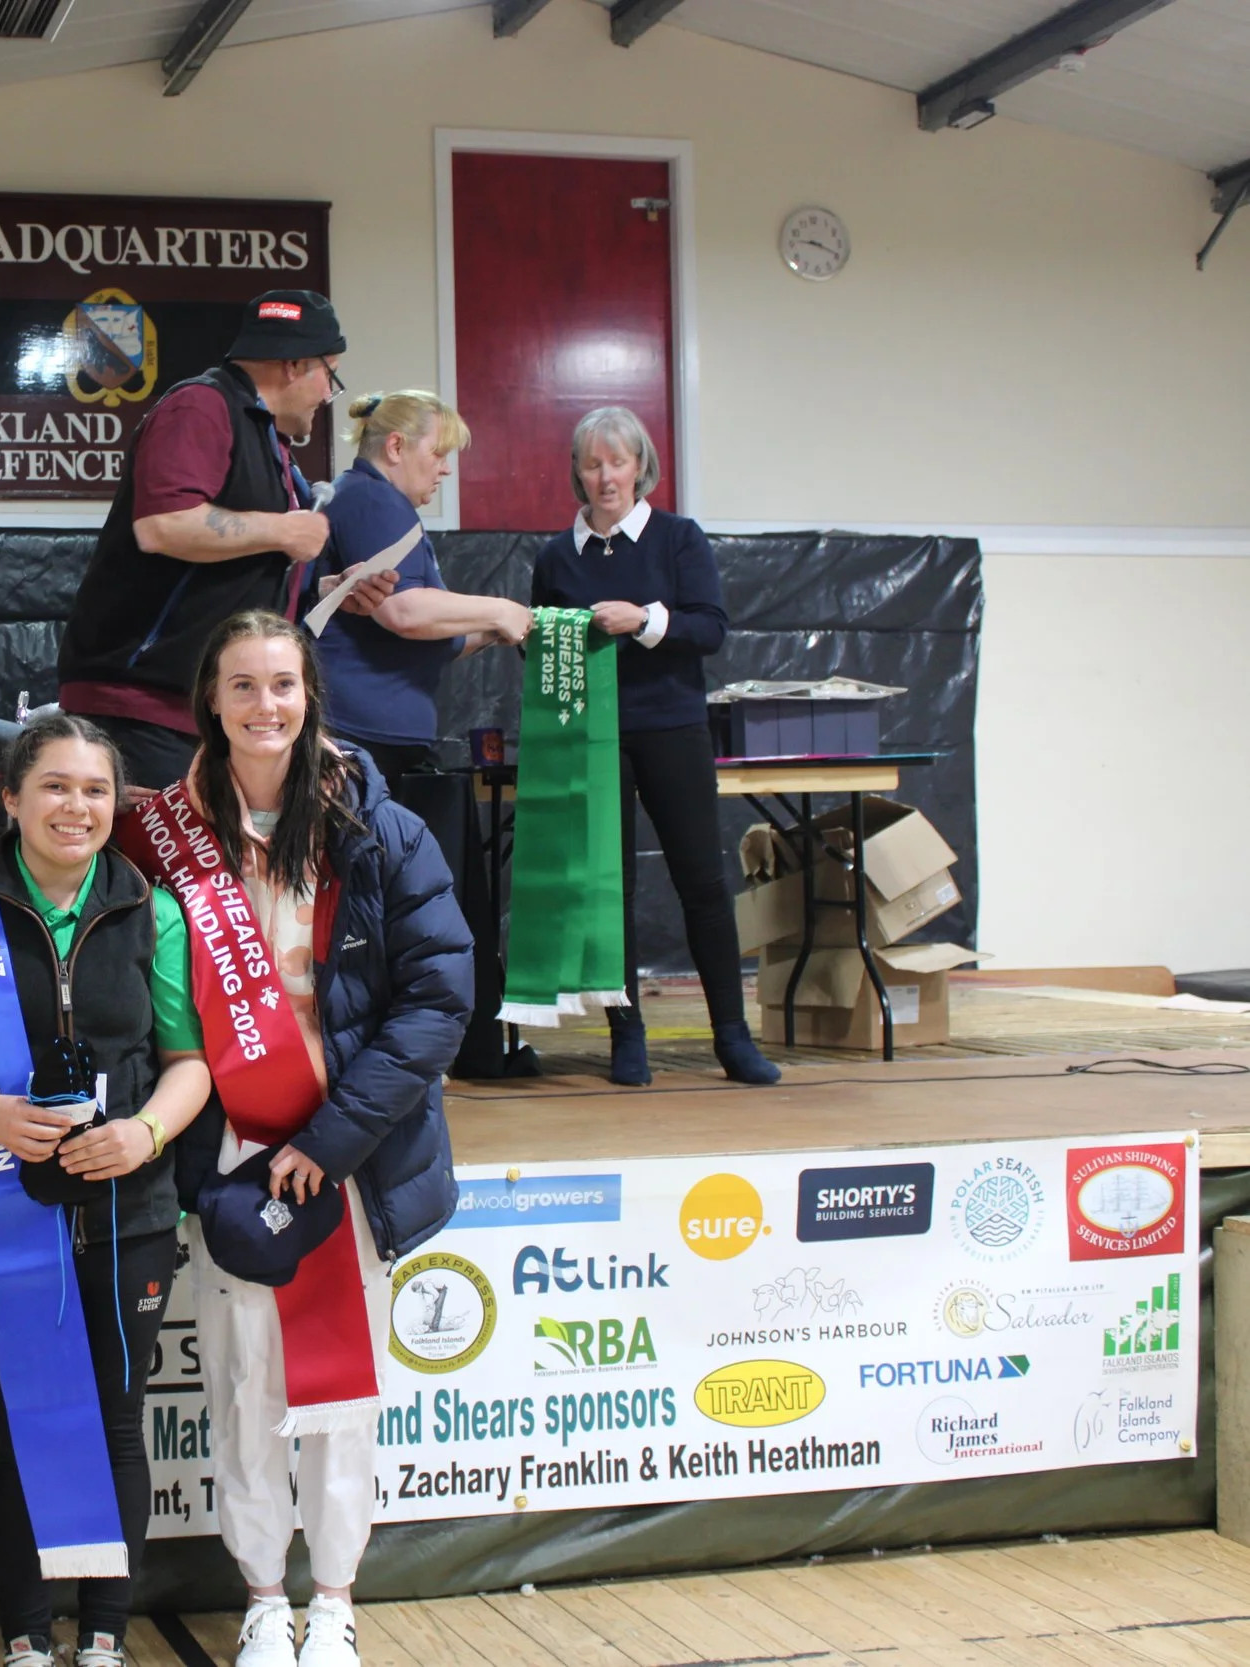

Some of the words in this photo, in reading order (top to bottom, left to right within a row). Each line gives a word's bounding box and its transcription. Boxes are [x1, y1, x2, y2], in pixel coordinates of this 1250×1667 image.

[258, 303, 301, 319] Heiniger
[541, 652, 555, 695] 2025
[558, 624, 572, 703] SHEARS
[141, 805, 180, 872] WOOL
[170, 865, 243, 997] HANDLING
[229, 999, 267, 1061] 2025
[210, 871, 270, 979] SHEARS
[951, 1161, 992, 1208] POLAR
[996, 1157, 1044, 1203] SEAFISH
[1072, 1151, 1122, 1183] SULIVAN
[1125, 1151, 1178, 1177] SHIPPING
[456, 1190, 604, 1212] dwoolgrowers
[816, 1183, 916, 1209] SHORTY'S
[816, 1209, 864, 1222] BUILDING
[869, 1206, 915, 1219] SERVICES
[1076, 1224, 1130, 1251] SERVICES
[1132, 1216, 1177, 1250] LIMITED
[429, 1256, 494, 1308] EXPRESS
[983, 1293, 1094, 1331] Salvador
[707, 1327, 811, 1348] JOHNSON'S
[819, 1322, 908, 1341] HARBOUR
[859, 1357, 991, 1389] FORTUNA
[1102, 1354, 1142, 1369] FALKLAND
[1144, 1352, 1180, 1365] ISLANDS
[705, 1375, 813, 1415] TRANT
[1119, 1394, 1172, 1412] Falkland
[433, 1387, 535, 1445] Shears
[545, 1385, 677, 1447] sponsors
[931, 1412, 999, 1434] Richard
[1118, 1412, 1161, 1428] Islands
[946, 1431, 999, 1453] James
[954, 1440, 1043, 1460] International
[1117, 1429, 1181, 1446] Company
[398, 1463, 511, 1501] Zachary
[521, 1449, 629, 1490] Franklin
[639, 1446, 659, 1481] &
[669, 1441, 738, 1479] Keith
[748, 1436, 881, 1475] Heathman
